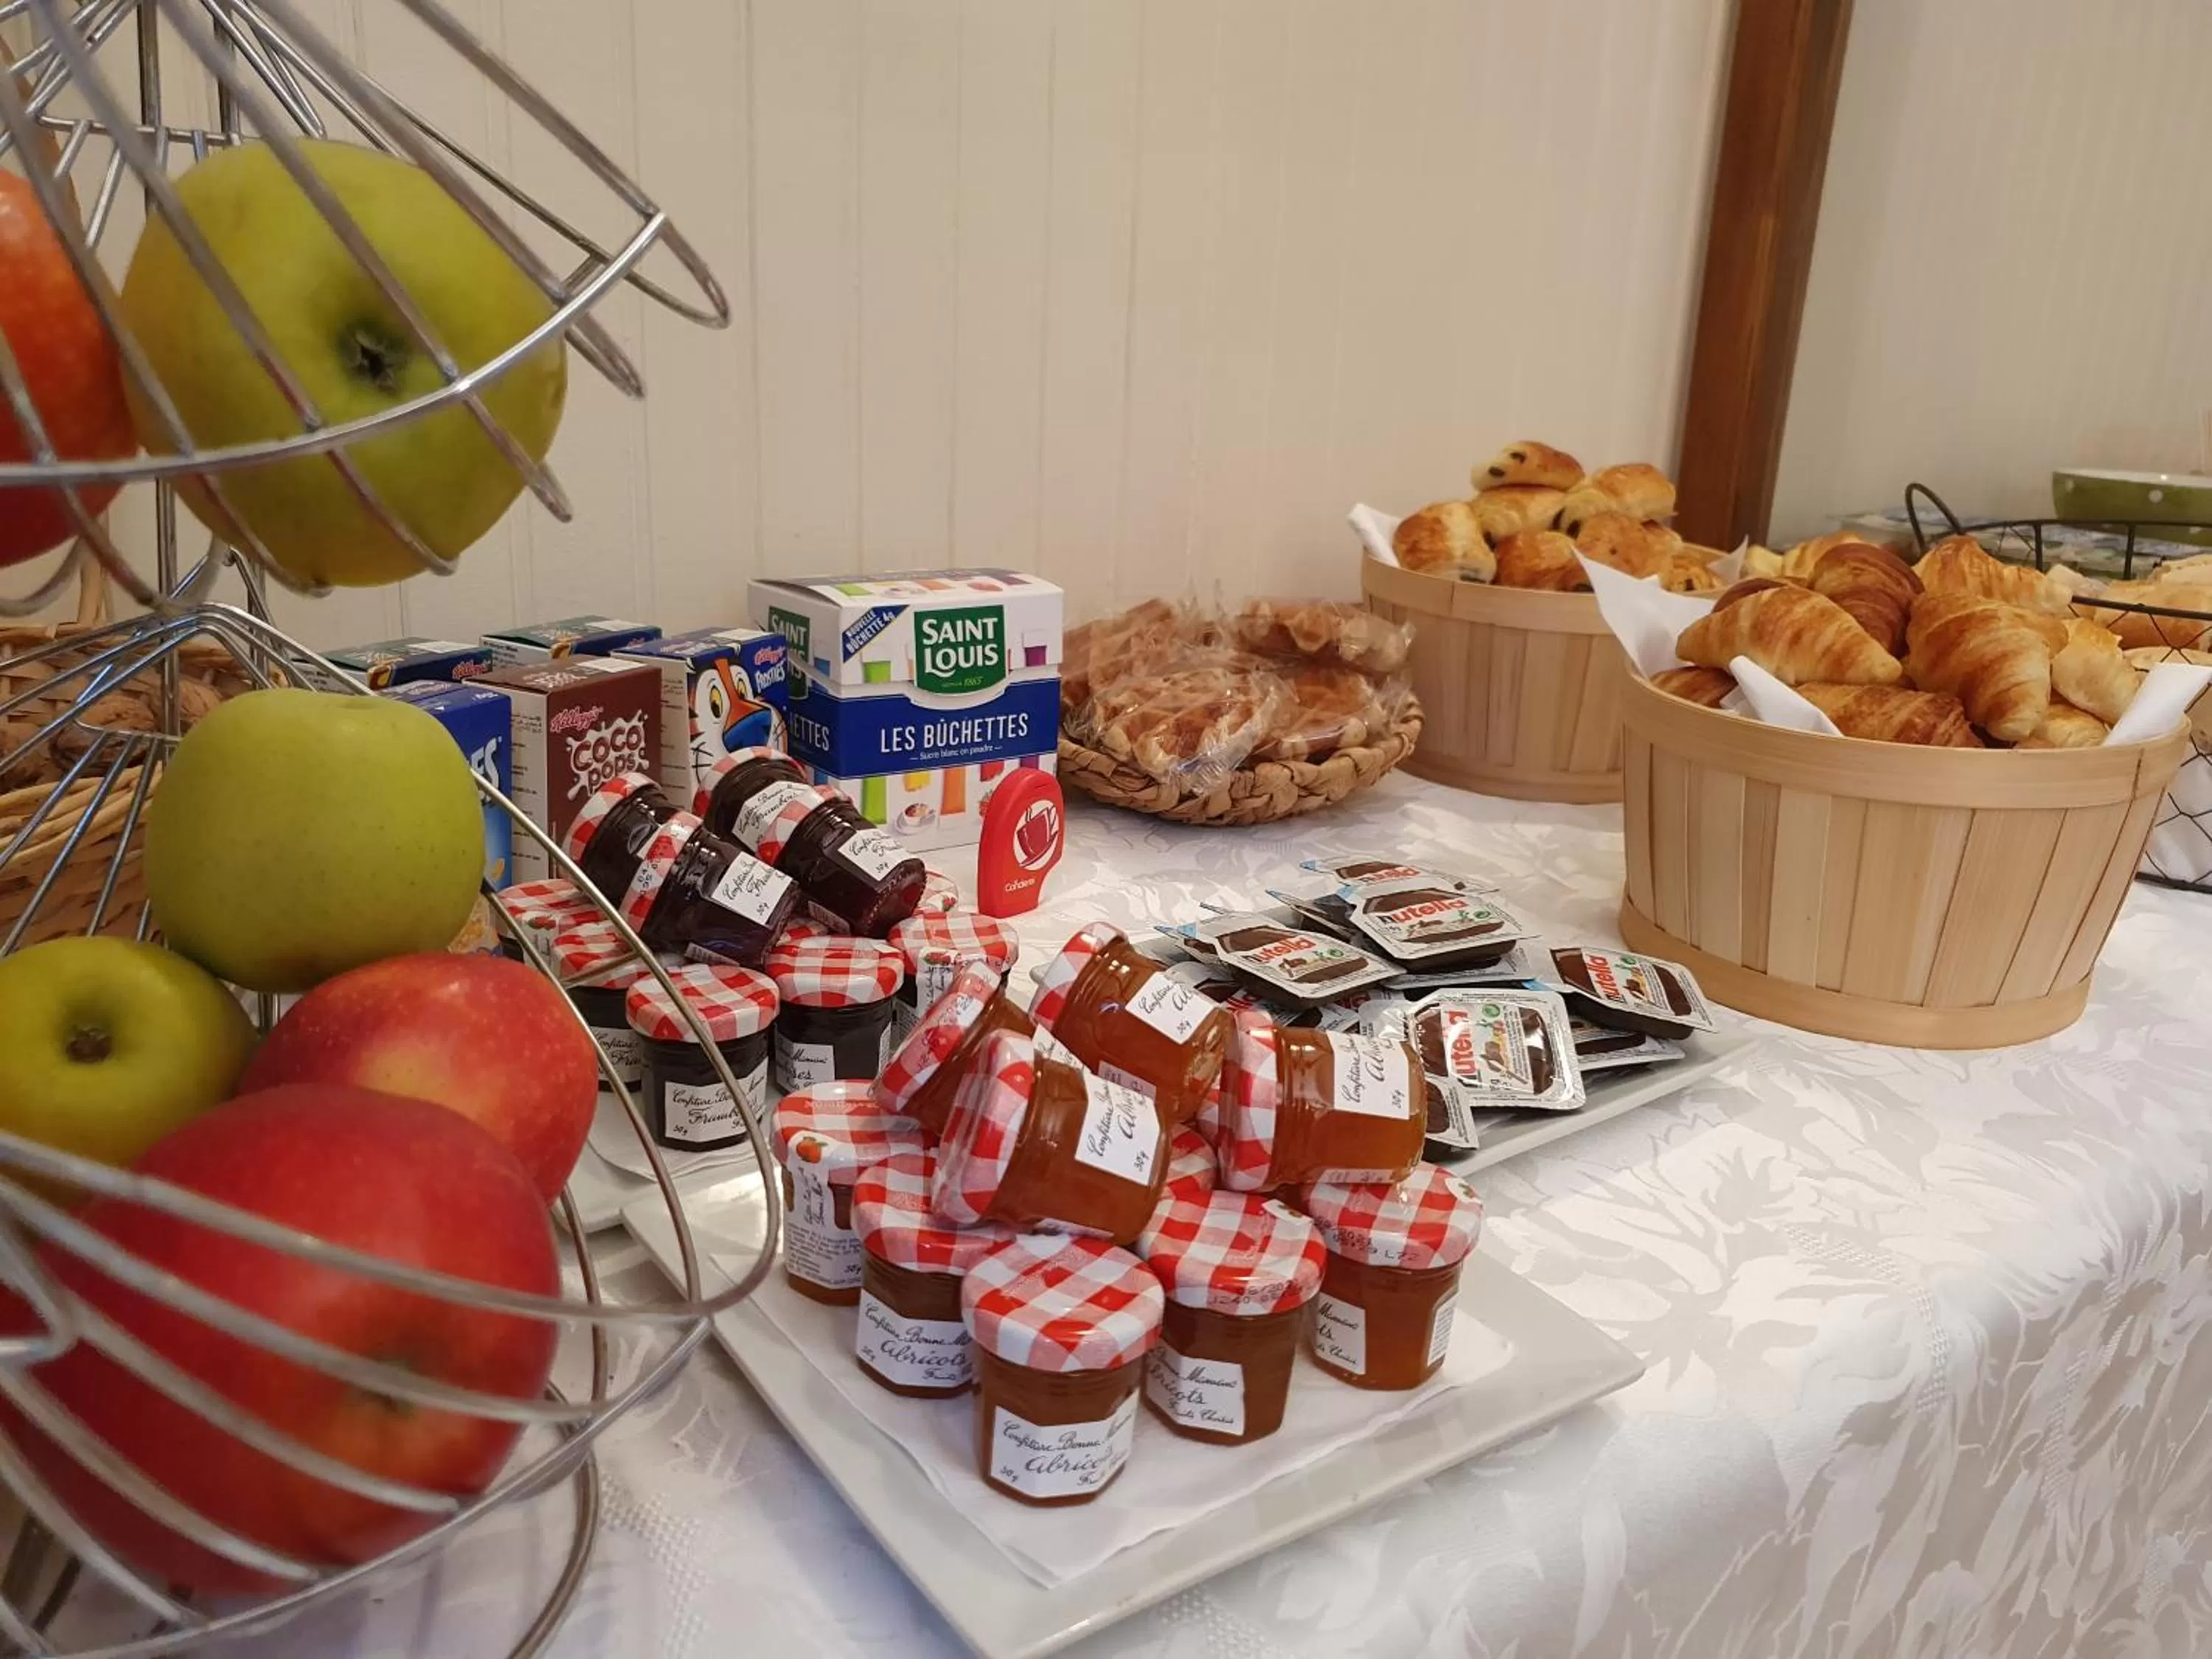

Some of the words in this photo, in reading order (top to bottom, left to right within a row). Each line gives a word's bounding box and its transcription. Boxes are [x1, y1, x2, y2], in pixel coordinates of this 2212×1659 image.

[922, 617, 998, 645] SAINT
[924, 643, 999, 678] LOUIS
[549, 705, 604, 733] Kellogg's
[789, 710, 830, 751] ETTES
[880, 726, 916, 753] LES
[1377, 898, 1469, 924] nutella
[1242, 934, 1317, 964] nutella
[672, 1088, 713, 1107] Confiture
[1003, 1419, 1056, 1452] Confiture
